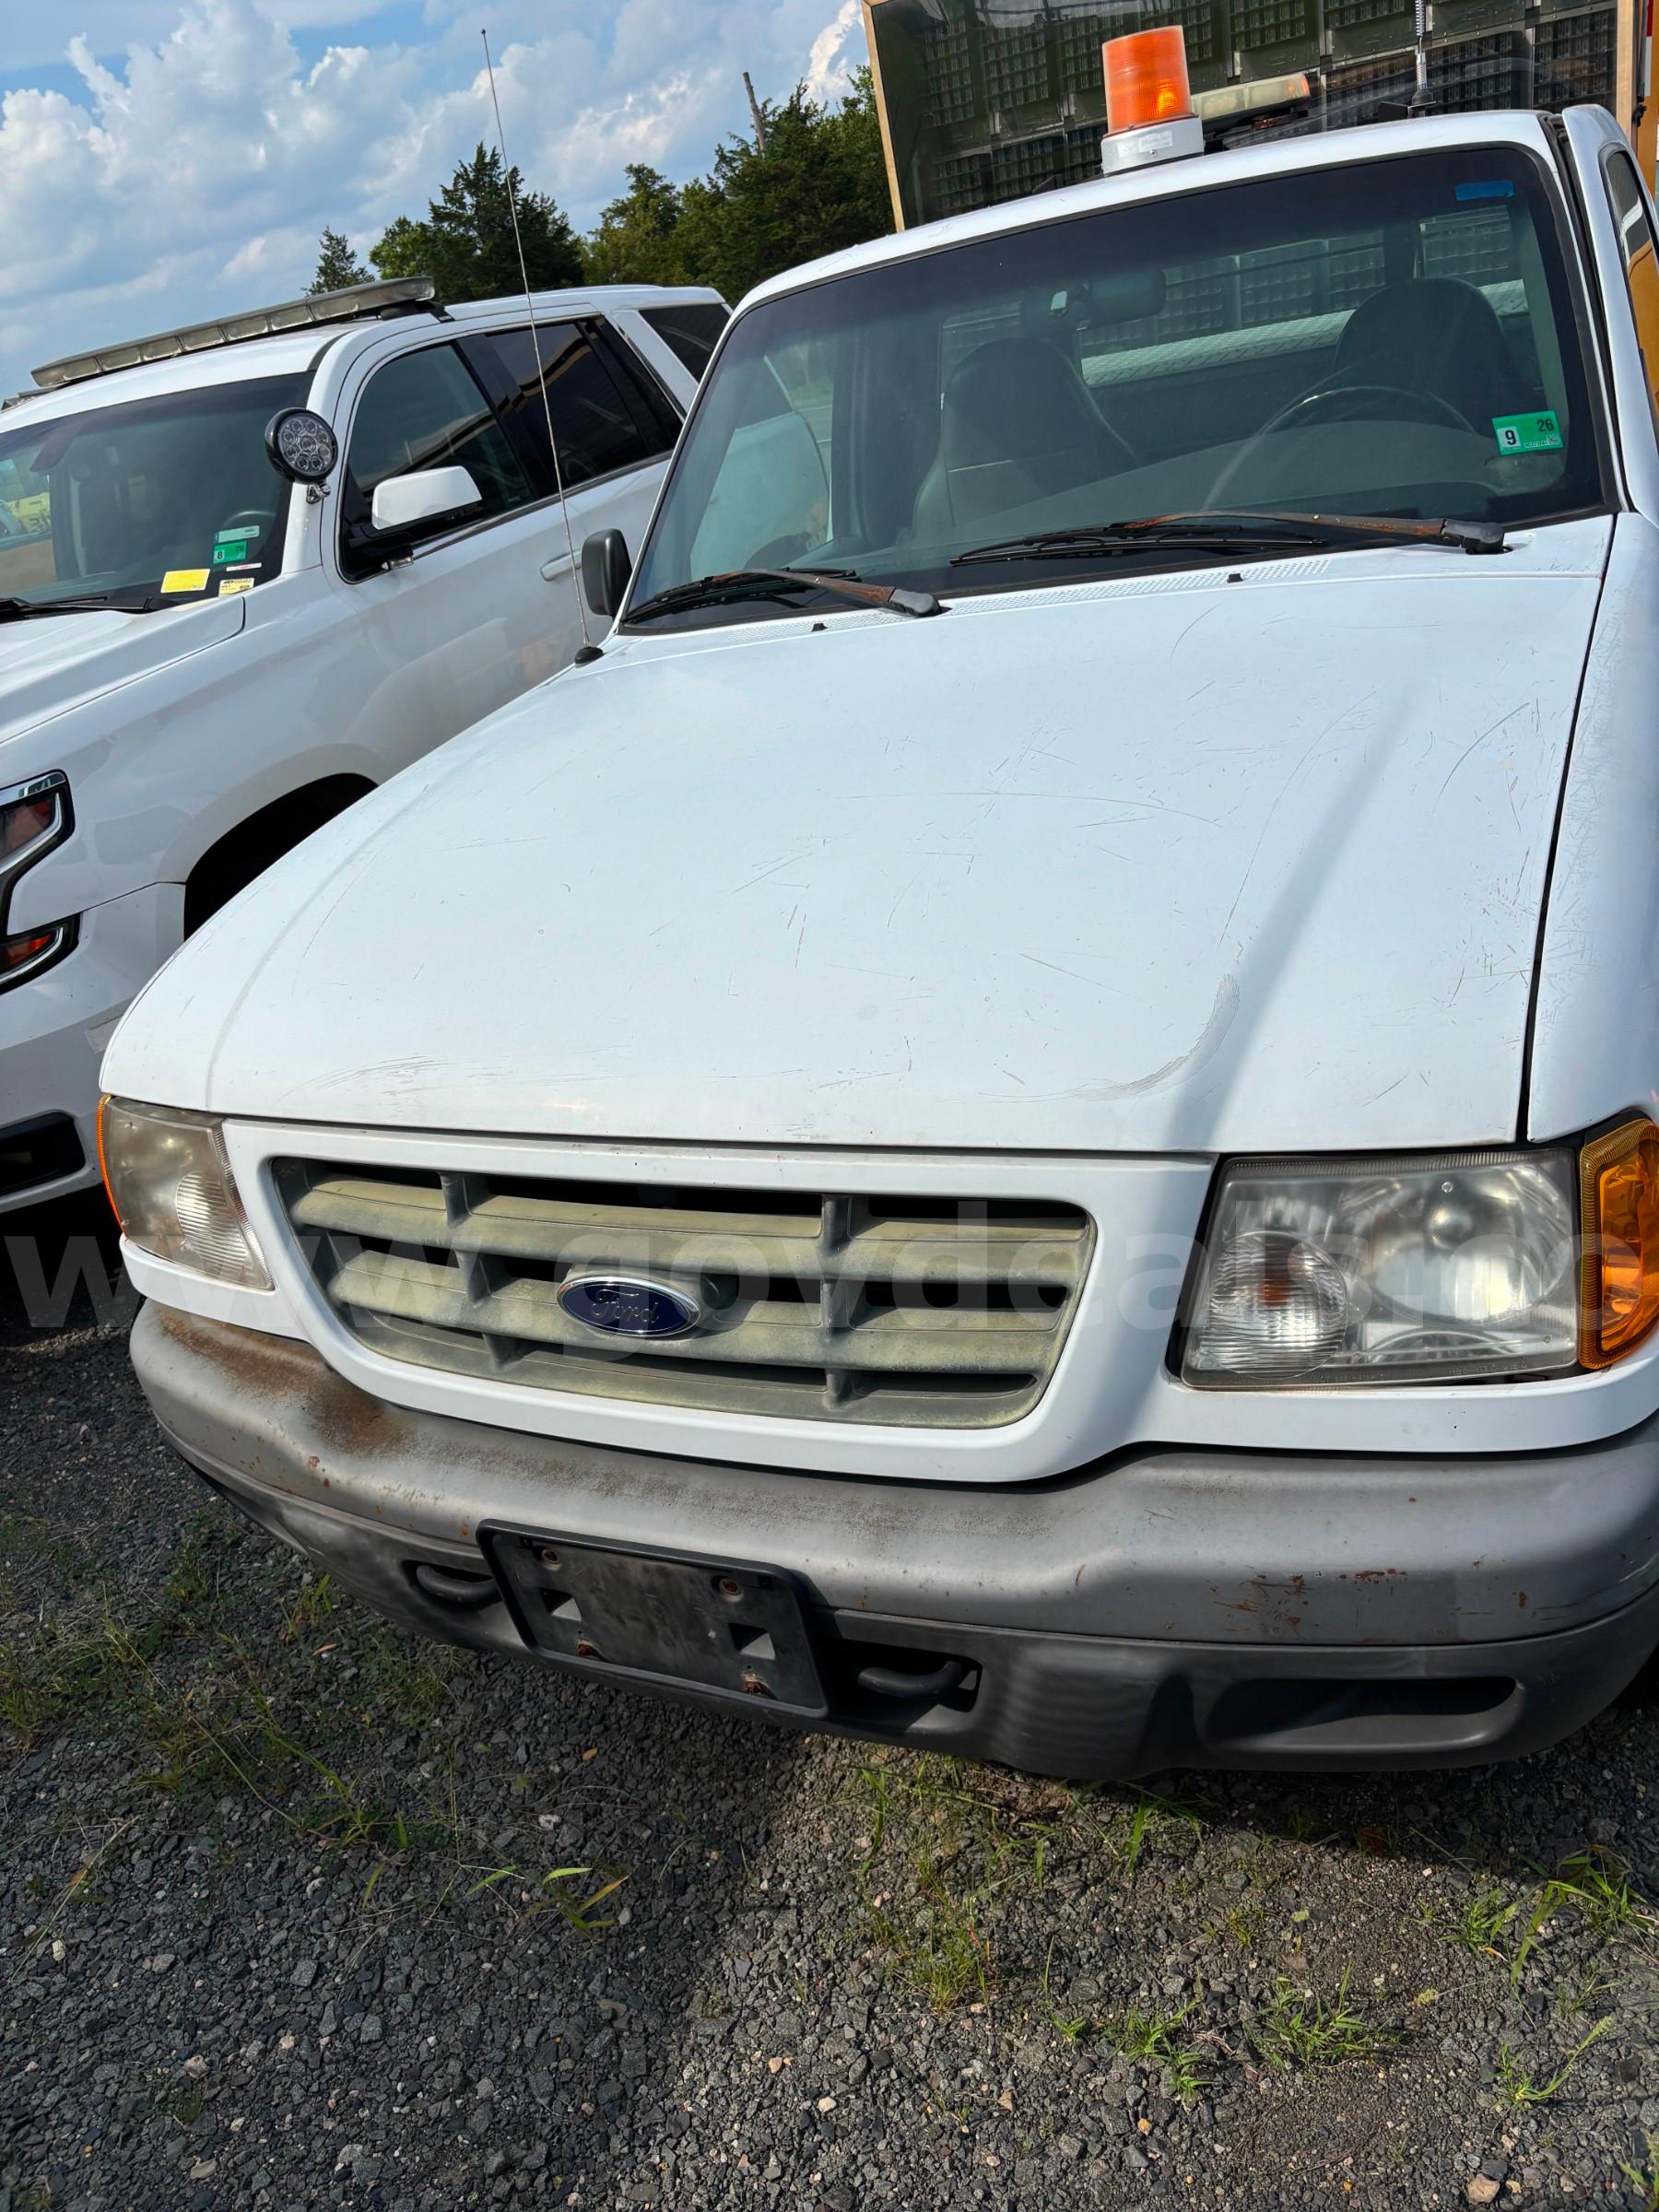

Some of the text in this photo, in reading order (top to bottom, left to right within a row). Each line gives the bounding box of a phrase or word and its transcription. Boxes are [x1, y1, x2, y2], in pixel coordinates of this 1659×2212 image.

[1536, 418, 1555, 432] 26
[1505, 429, 1517, 446] 9
[217, 551, 224, 559] 8
[590, 1288, 660, 1324] Ford
